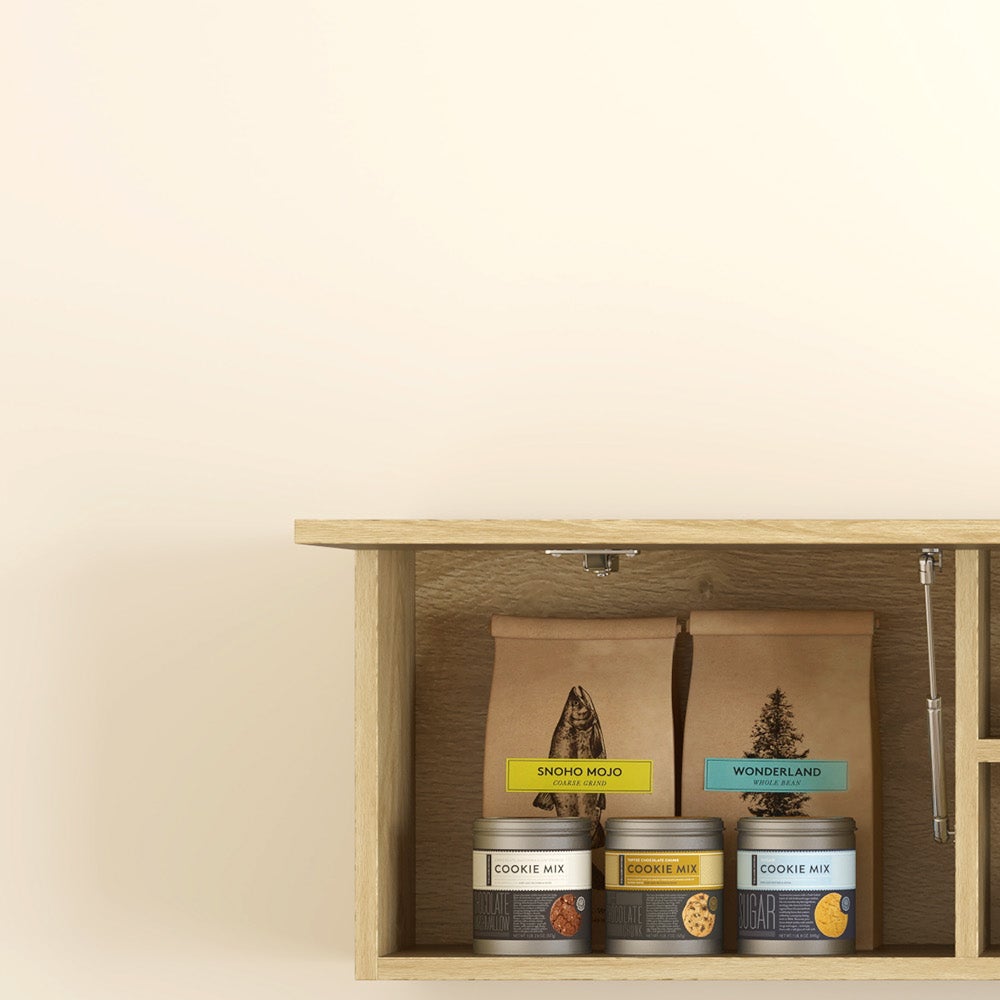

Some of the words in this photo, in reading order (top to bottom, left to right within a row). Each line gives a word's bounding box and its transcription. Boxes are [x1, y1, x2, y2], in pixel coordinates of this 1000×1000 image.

[538, 766, 583, 776] SNOHO
[586, 767, 622, 776] MOJO
[733, 766, 822, 776] WONDERLAND
[494, 864, 540, 873] COOKIE
[544, 864, 564, 873] MIX
[627, 864, 672, 873] COOKIE
[676, 864, 697, 873] MIX
[760, 864, 805, 873] COOKIE
[810, 864, 830, 873] MIX
[738, 893, 776, 930] SUGAR
